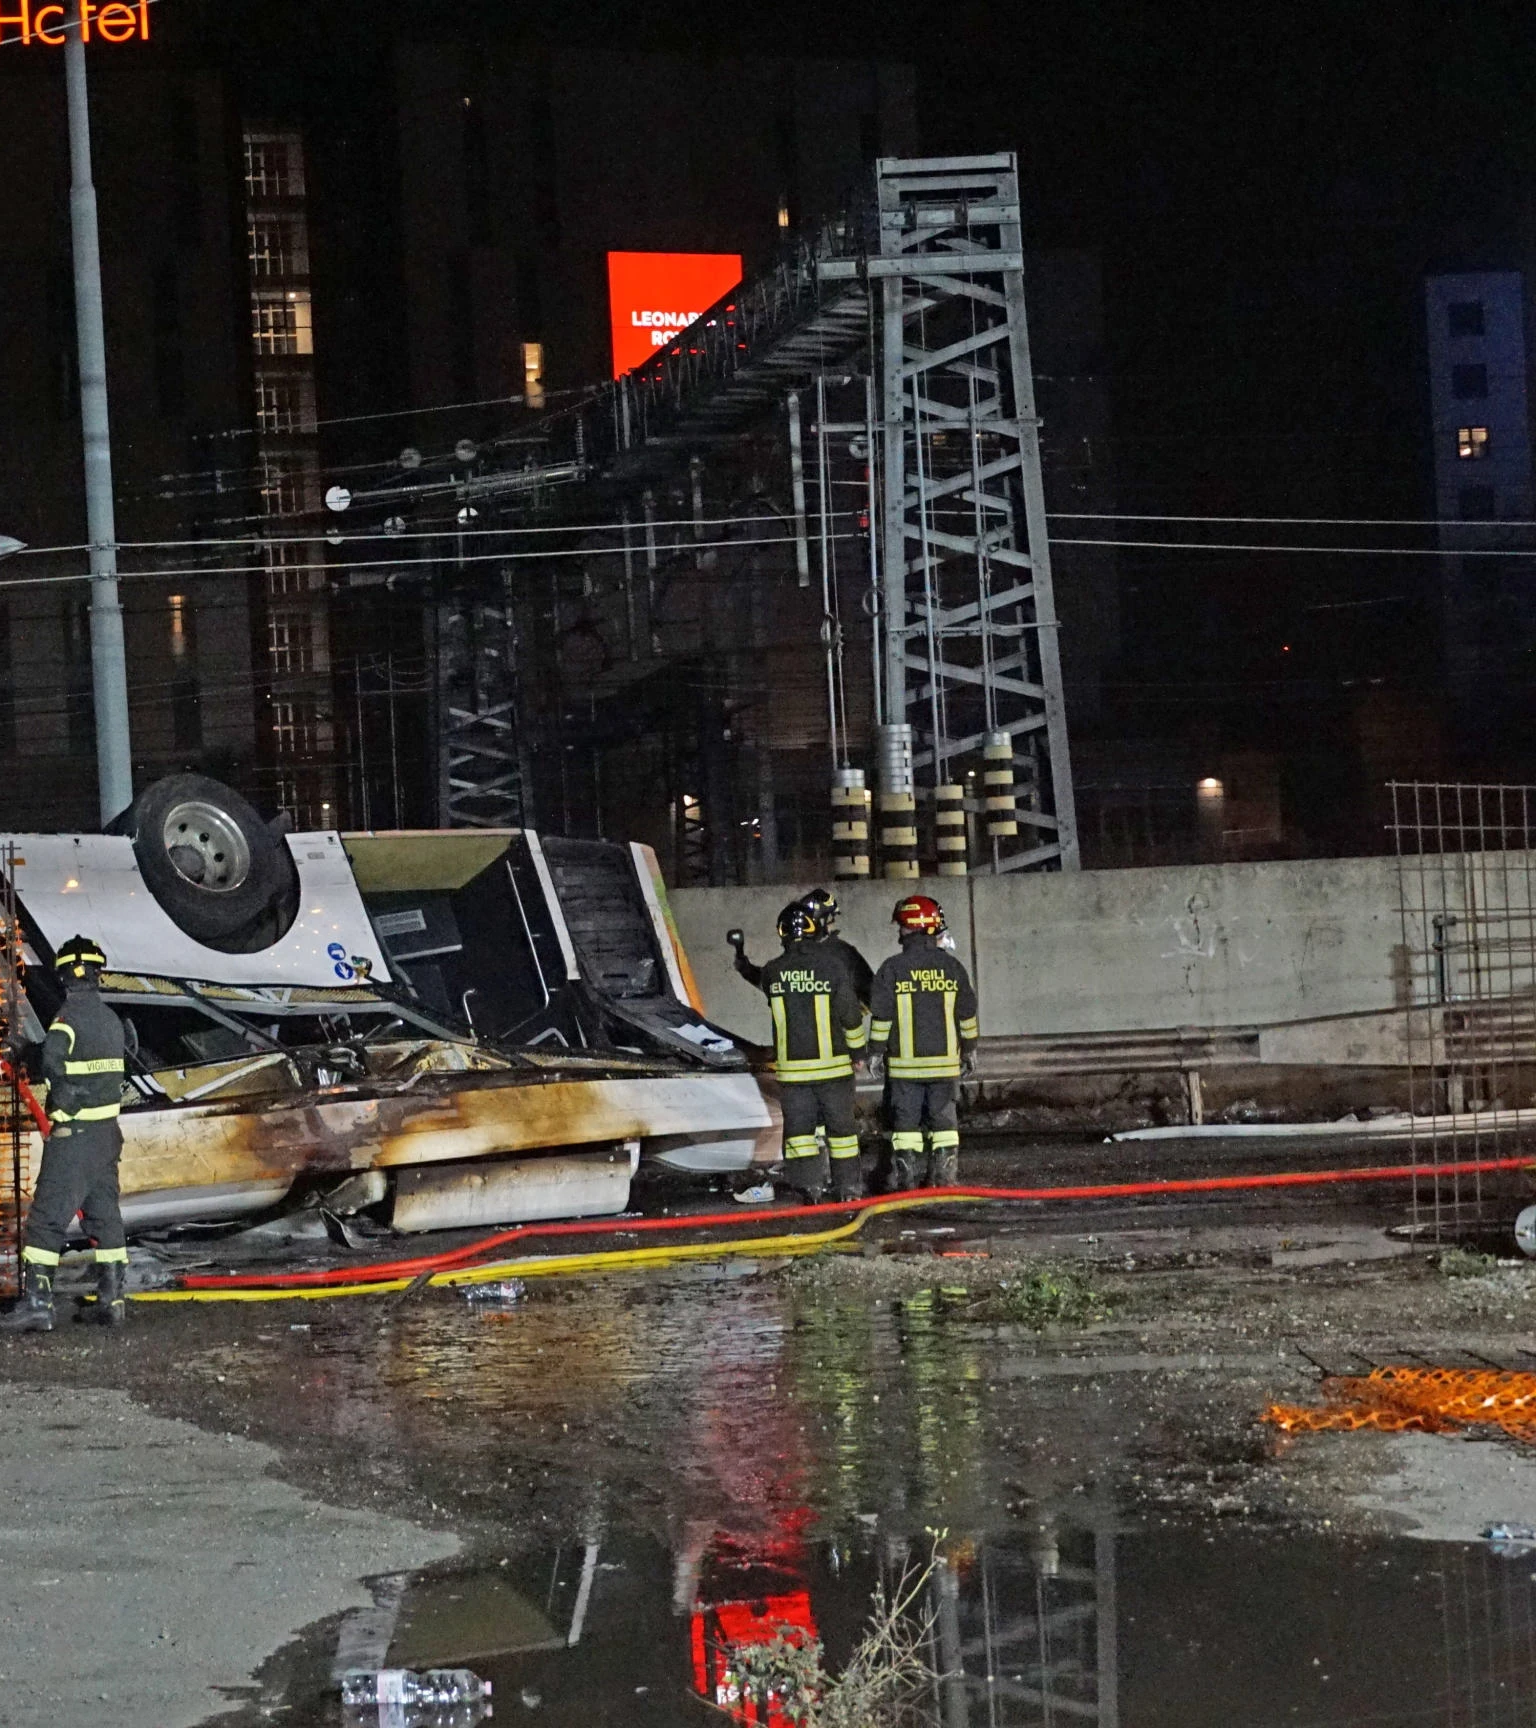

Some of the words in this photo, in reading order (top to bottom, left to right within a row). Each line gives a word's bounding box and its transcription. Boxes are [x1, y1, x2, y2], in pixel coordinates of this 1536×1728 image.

[779, 969, 816, 982] VIGILI
[910, 968, 945, 981] VIGILI
[769, 982, 786, 994] EL
